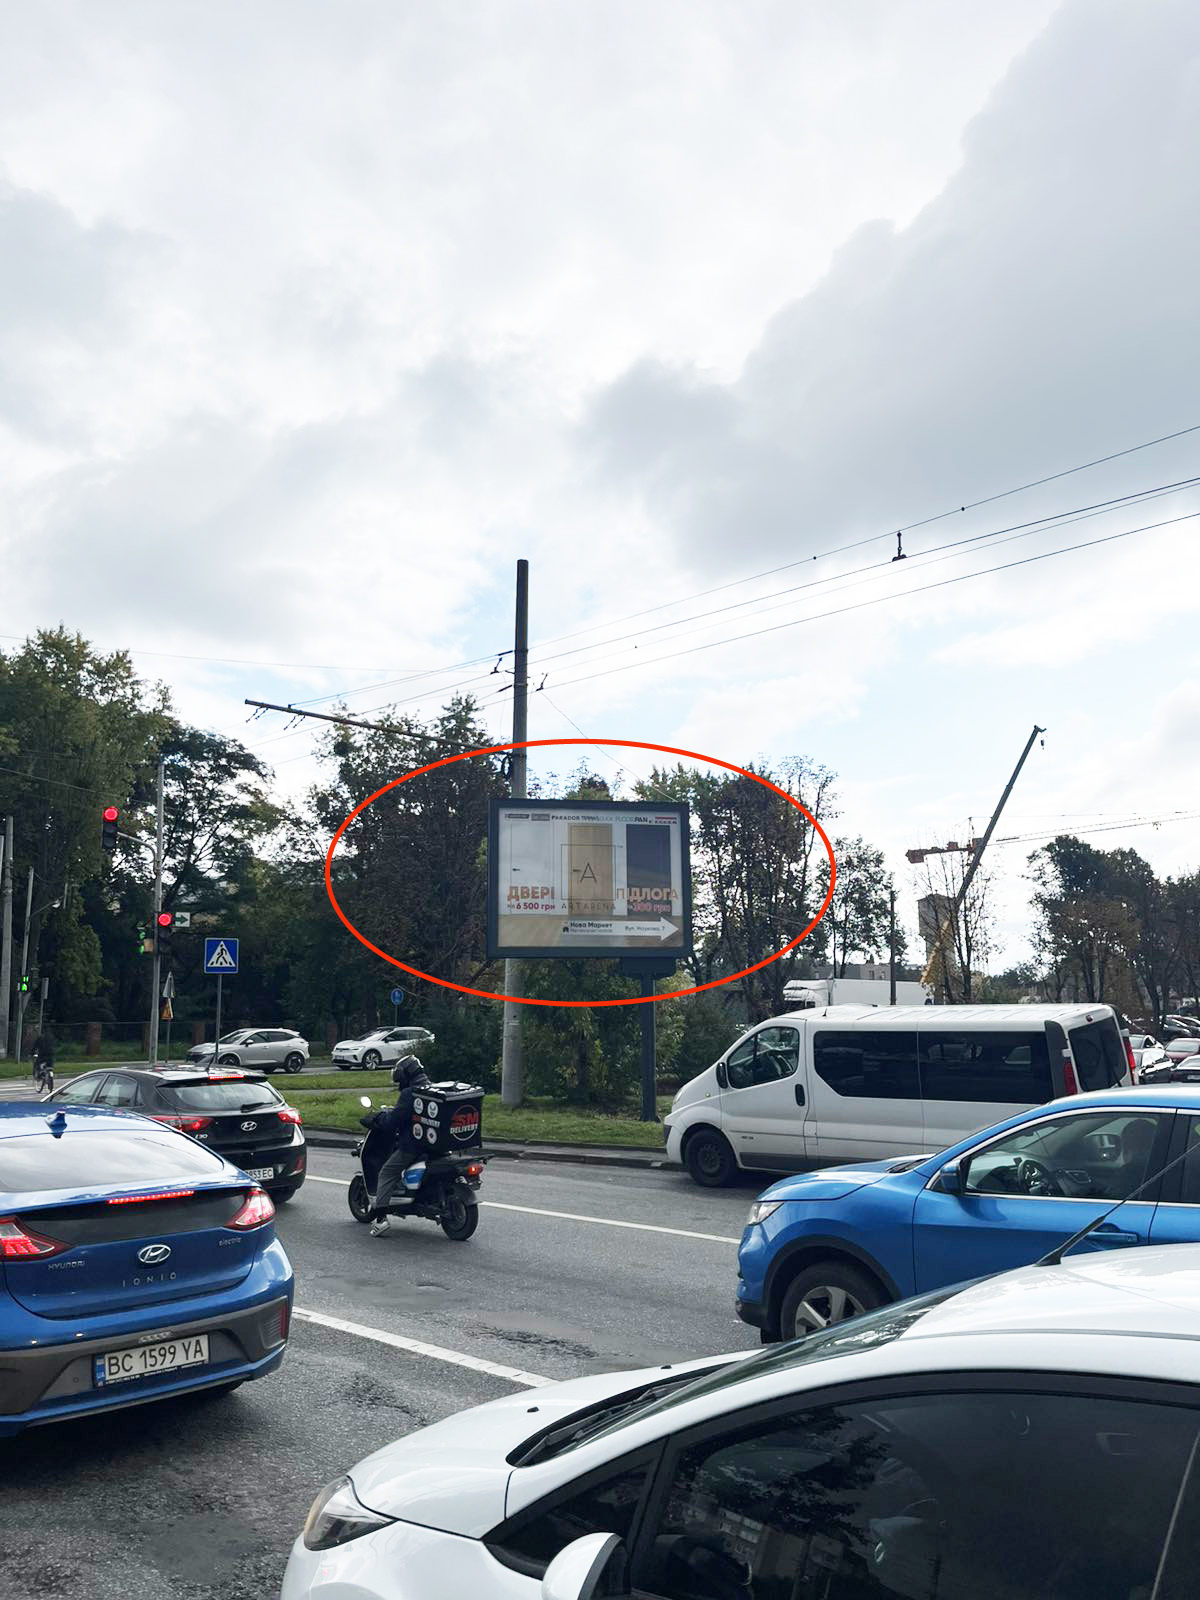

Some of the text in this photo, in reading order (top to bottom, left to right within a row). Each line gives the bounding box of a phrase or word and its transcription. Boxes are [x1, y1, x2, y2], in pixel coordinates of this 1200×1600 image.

[507, 886, 555, 901] ДВЕРІ
[617, 887, 679, 902] ПІДЛОГА
[516, 902, 522, 910] 6
[523, 902, 539, 910] 500
[541, 904, 555, 912] грн
[108, 1353, 133, 1376] BC
[139, 1344, 177, 1369] 1599
[182, 1339, 204, 1361] YA
